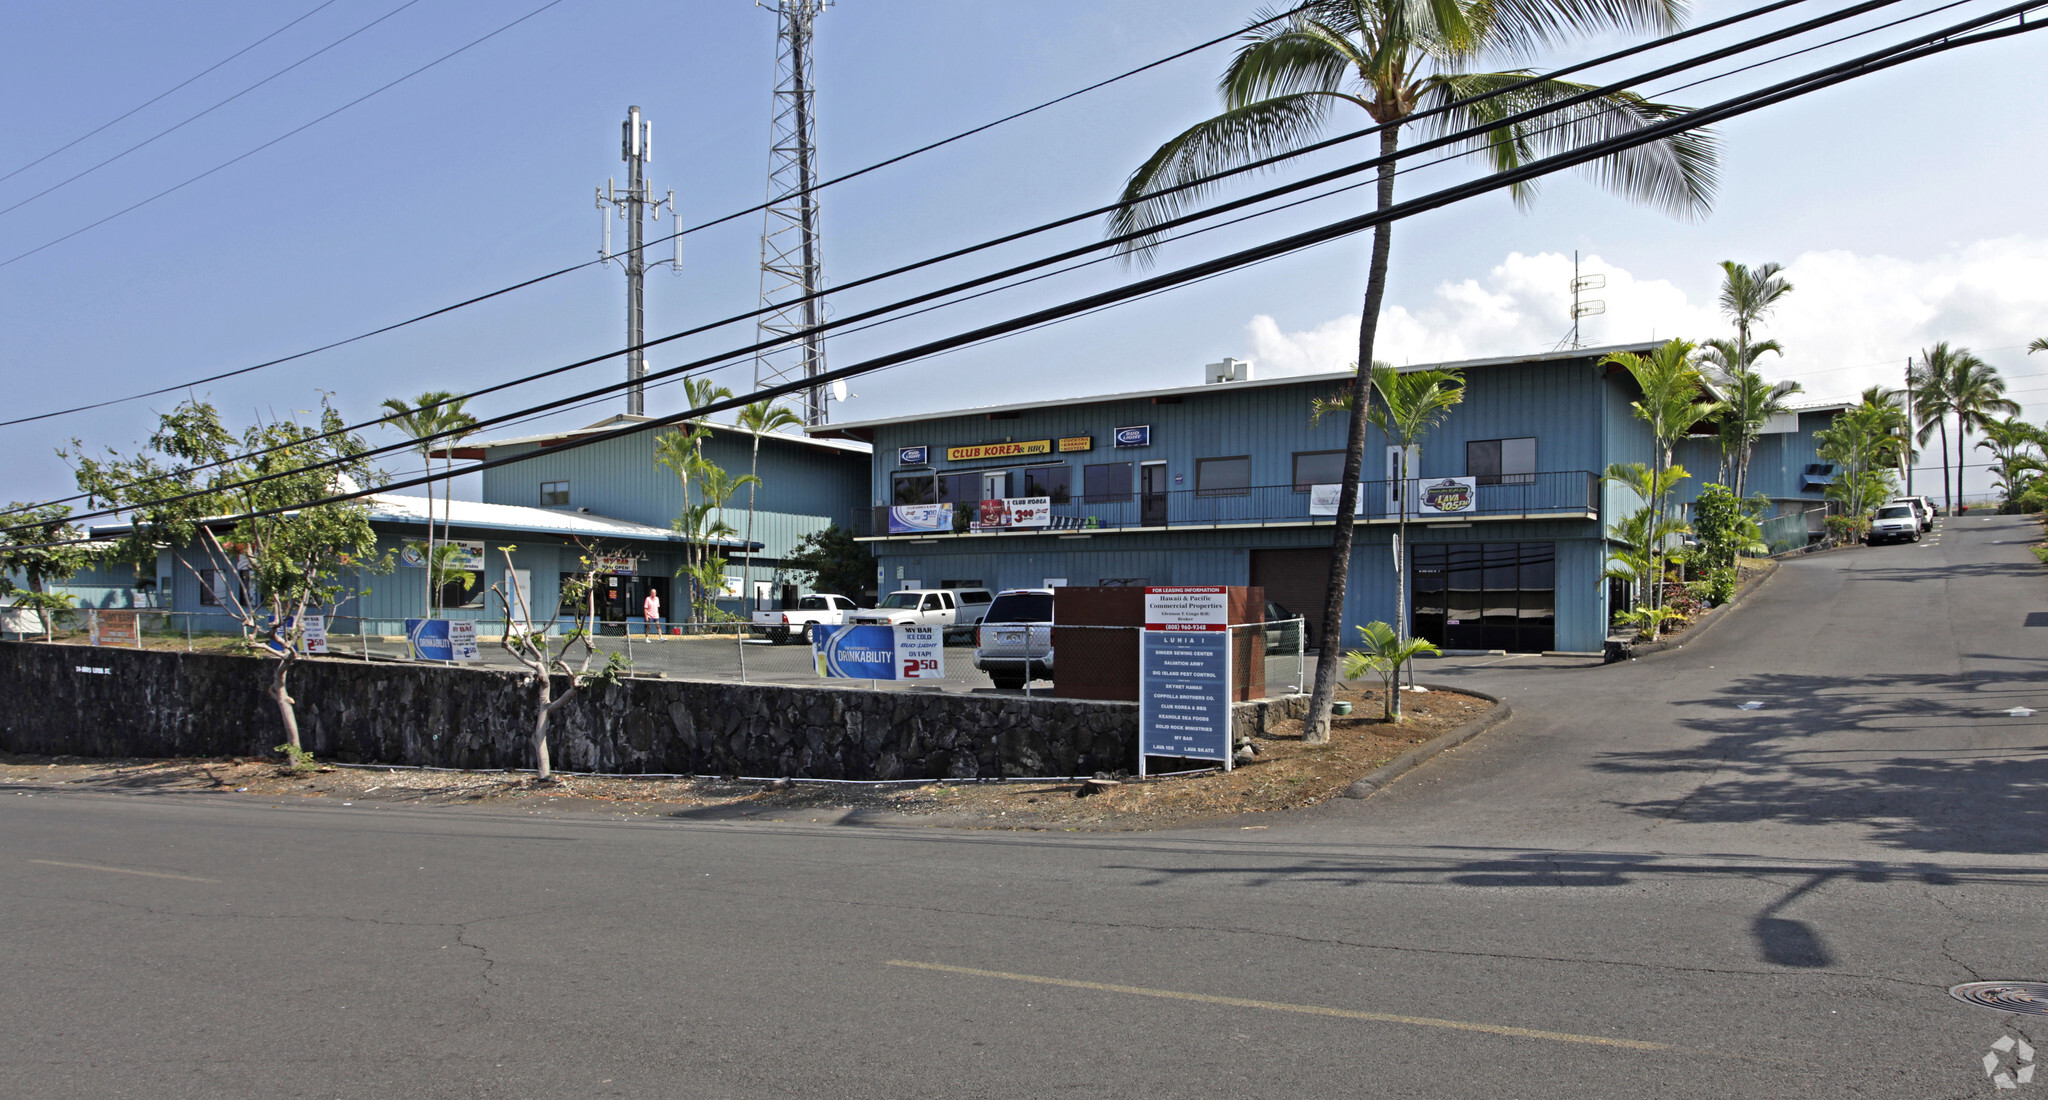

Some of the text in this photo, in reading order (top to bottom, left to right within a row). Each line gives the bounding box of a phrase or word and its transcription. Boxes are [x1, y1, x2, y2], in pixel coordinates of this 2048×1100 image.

[953, 448, 980, 458] CLUB
[984, 445, 1020, 456] KOREA
[1028, 445, 1045, 453] BBQ
[1438, 494, 1459, 504] LAVA
[1441, 501, 1458, 511] 105
[838, 650, 891, 663] DRINKABILITY
